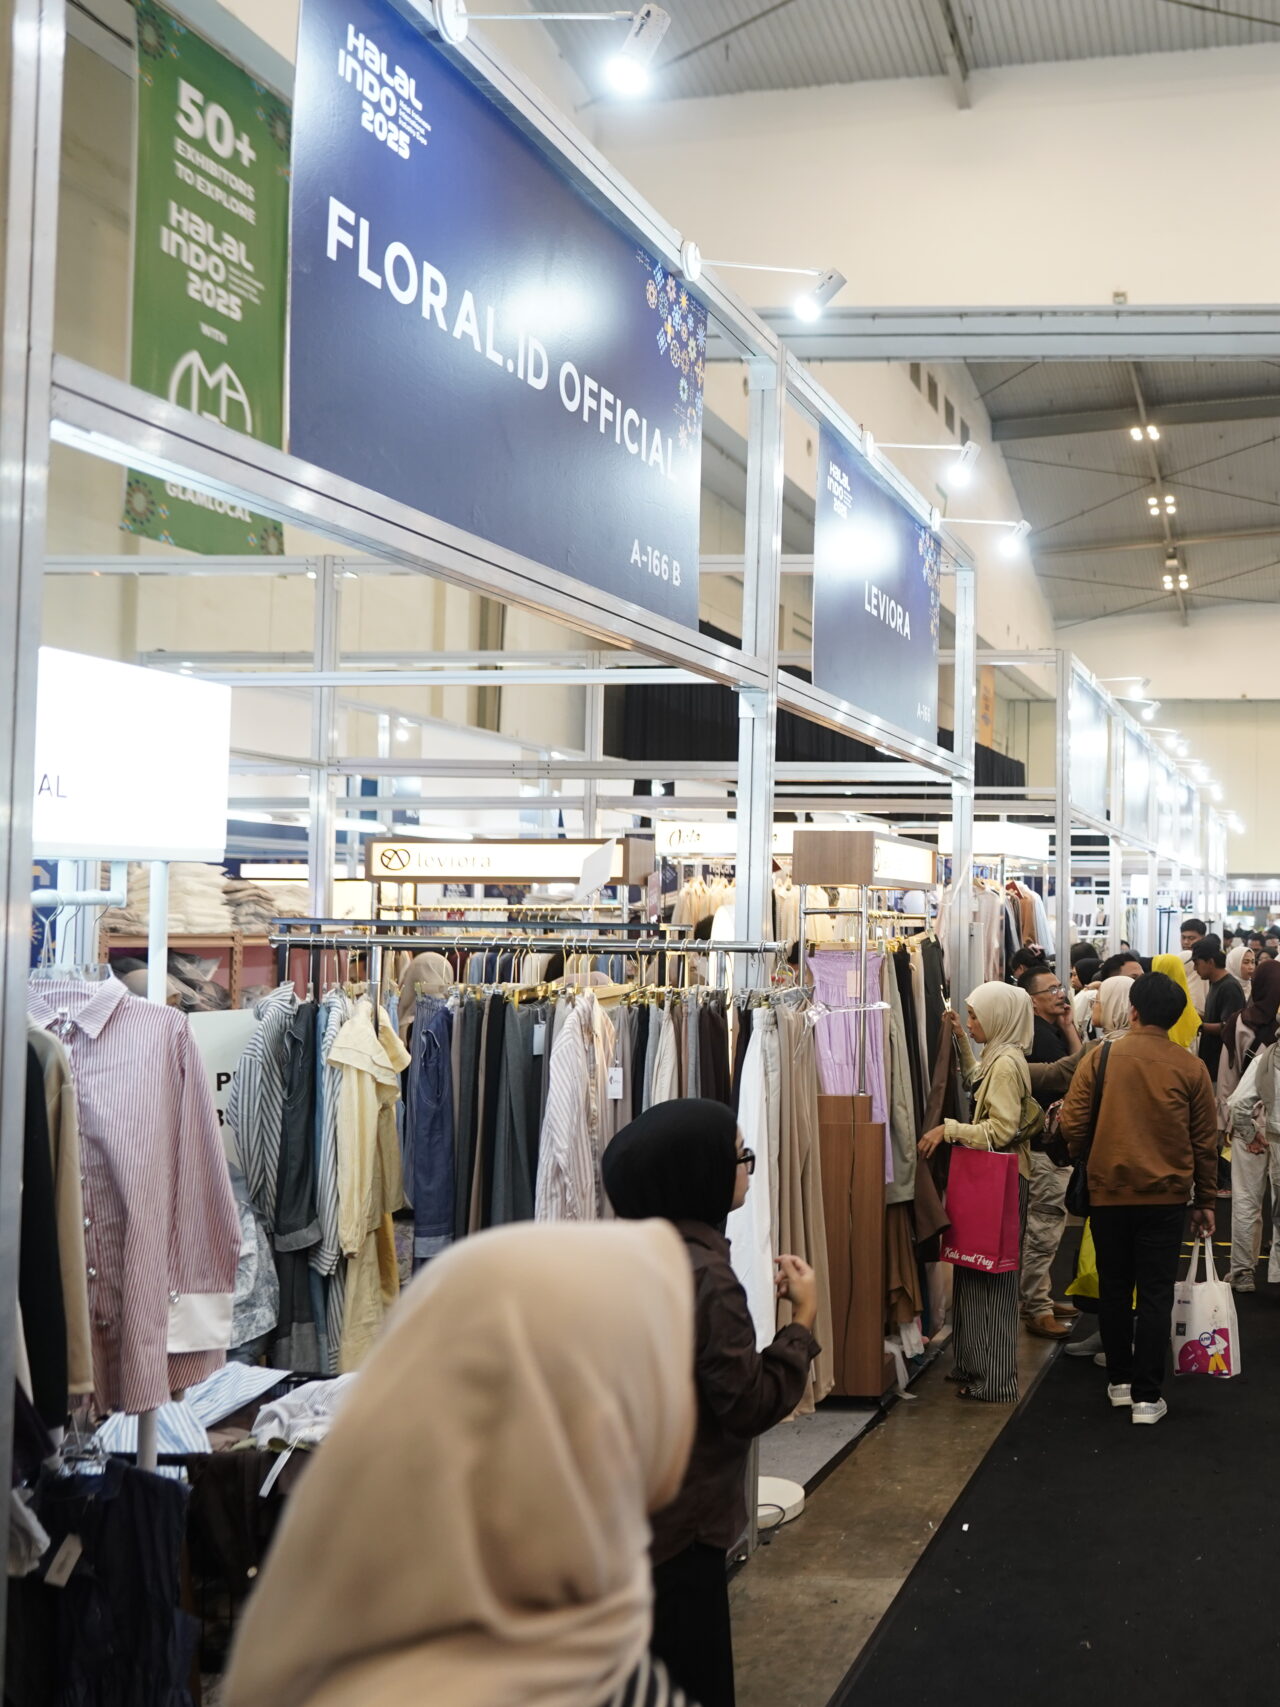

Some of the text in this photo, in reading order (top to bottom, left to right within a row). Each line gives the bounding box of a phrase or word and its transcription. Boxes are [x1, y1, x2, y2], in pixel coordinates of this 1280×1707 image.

[176, 77, 257, 168] 50+
[361, 100, 411, 160] 2025
[174, 136, 256, 202] EXHIBITORS
[174, 160, 257, 226] TO EXPLORE
[187, 270, 243, 322] 2025
[326, 195, 679, 483] FLORAL.ID OFFICIAL
[630, 538, 682, 587] A-166 B
[864, 580, 911, 641] LEVIORA
[961, 1253, 977, 1264] and
